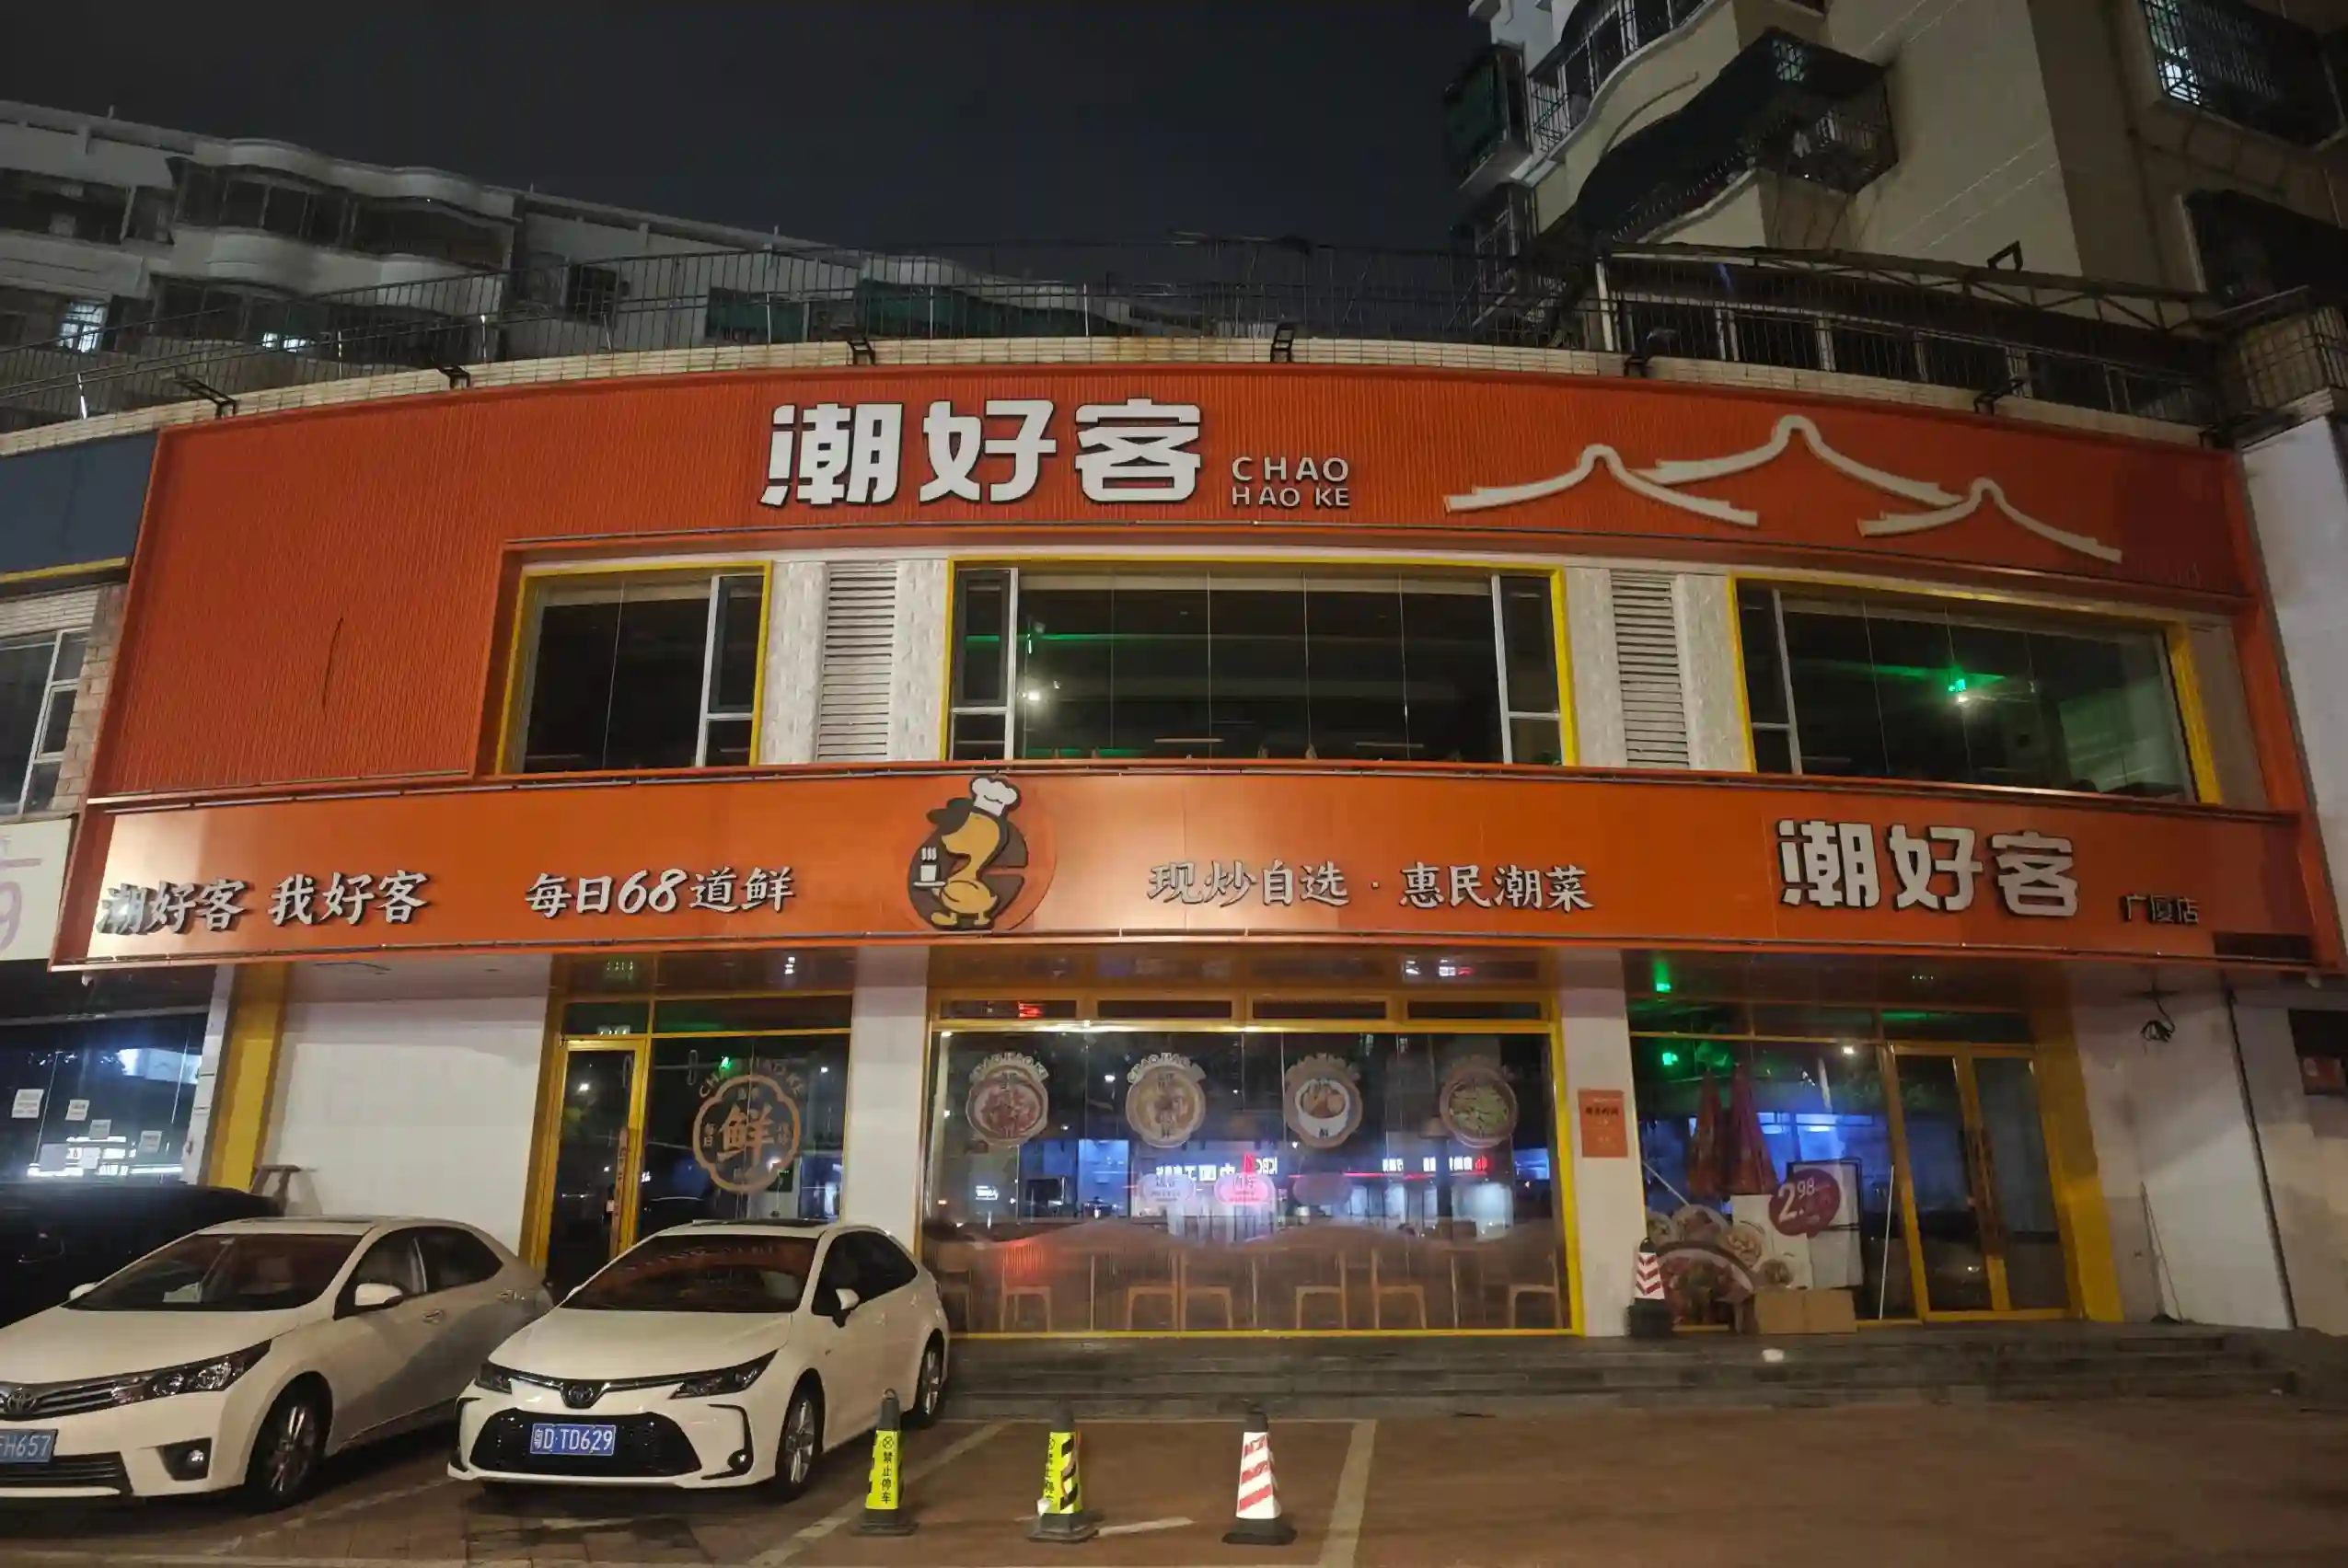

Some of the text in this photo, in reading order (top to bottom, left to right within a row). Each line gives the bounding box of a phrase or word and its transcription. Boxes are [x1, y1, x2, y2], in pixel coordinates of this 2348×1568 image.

[759, 398, 1201, 505] 潮好客
[1232, 456, 1349, 482] CHAO
[1232, 486, 1350, 507] HAO KE
[525, 867, 794, 918] 每日68道鲜
[1777, 819, 2078, 917] 潮好客
[267, 870, 429, 926] 我好客
[717, 1103, 775, 1170] 鲜
[880, 1451, 893, 1504] 禁止停车
